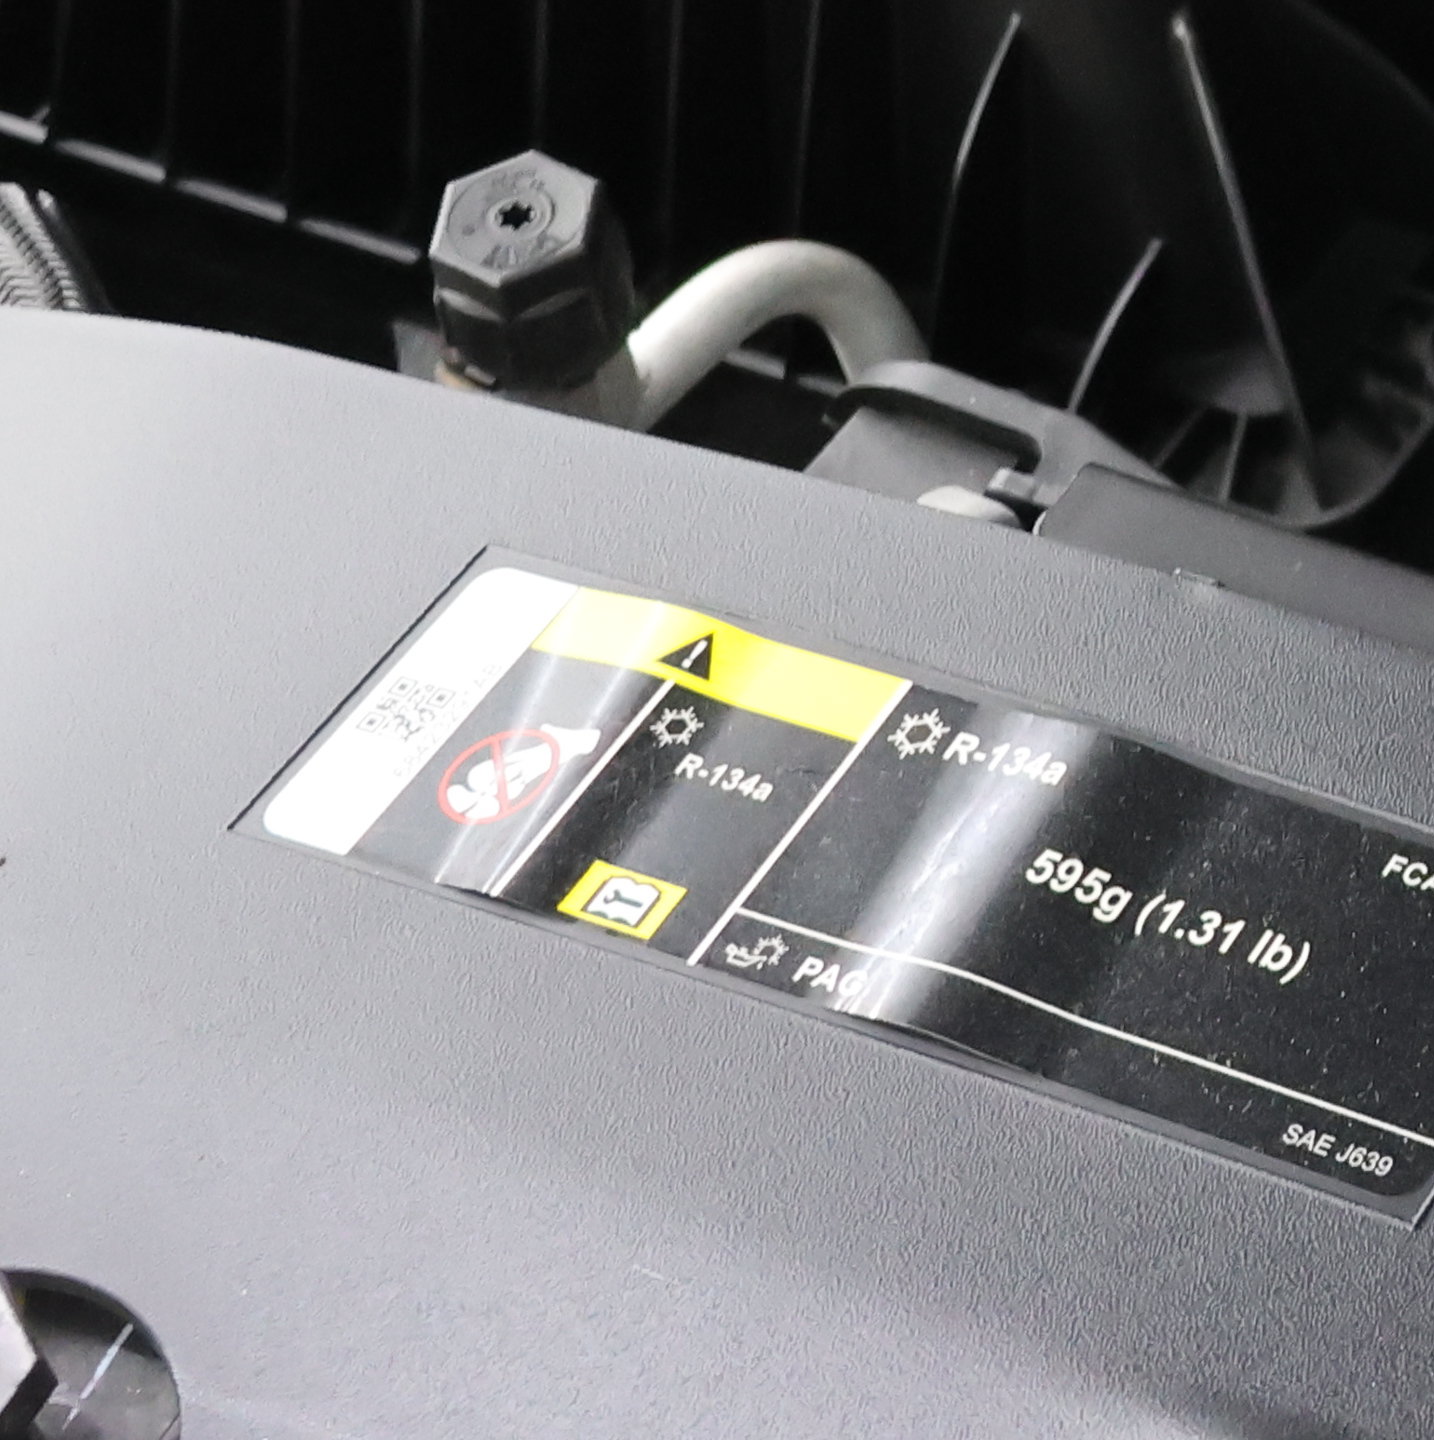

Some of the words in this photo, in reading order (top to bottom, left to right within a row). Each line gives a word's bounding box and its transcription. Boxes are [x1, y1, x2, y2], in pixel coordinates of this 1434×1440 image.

[674, 752, 774, 803] R-134a
[941, 731, 1068, 786] R-134a
[1025, 848, 1133, 924] 595g
[1134, 892, 1246, 955] (1.31
[1247, 928, 1312, 985] lb)
[791, 956, 868, 1000] PAG
[1282, 1123, 1336, 1158] SAE
[1335, 1142, 1394, 1178] J639
